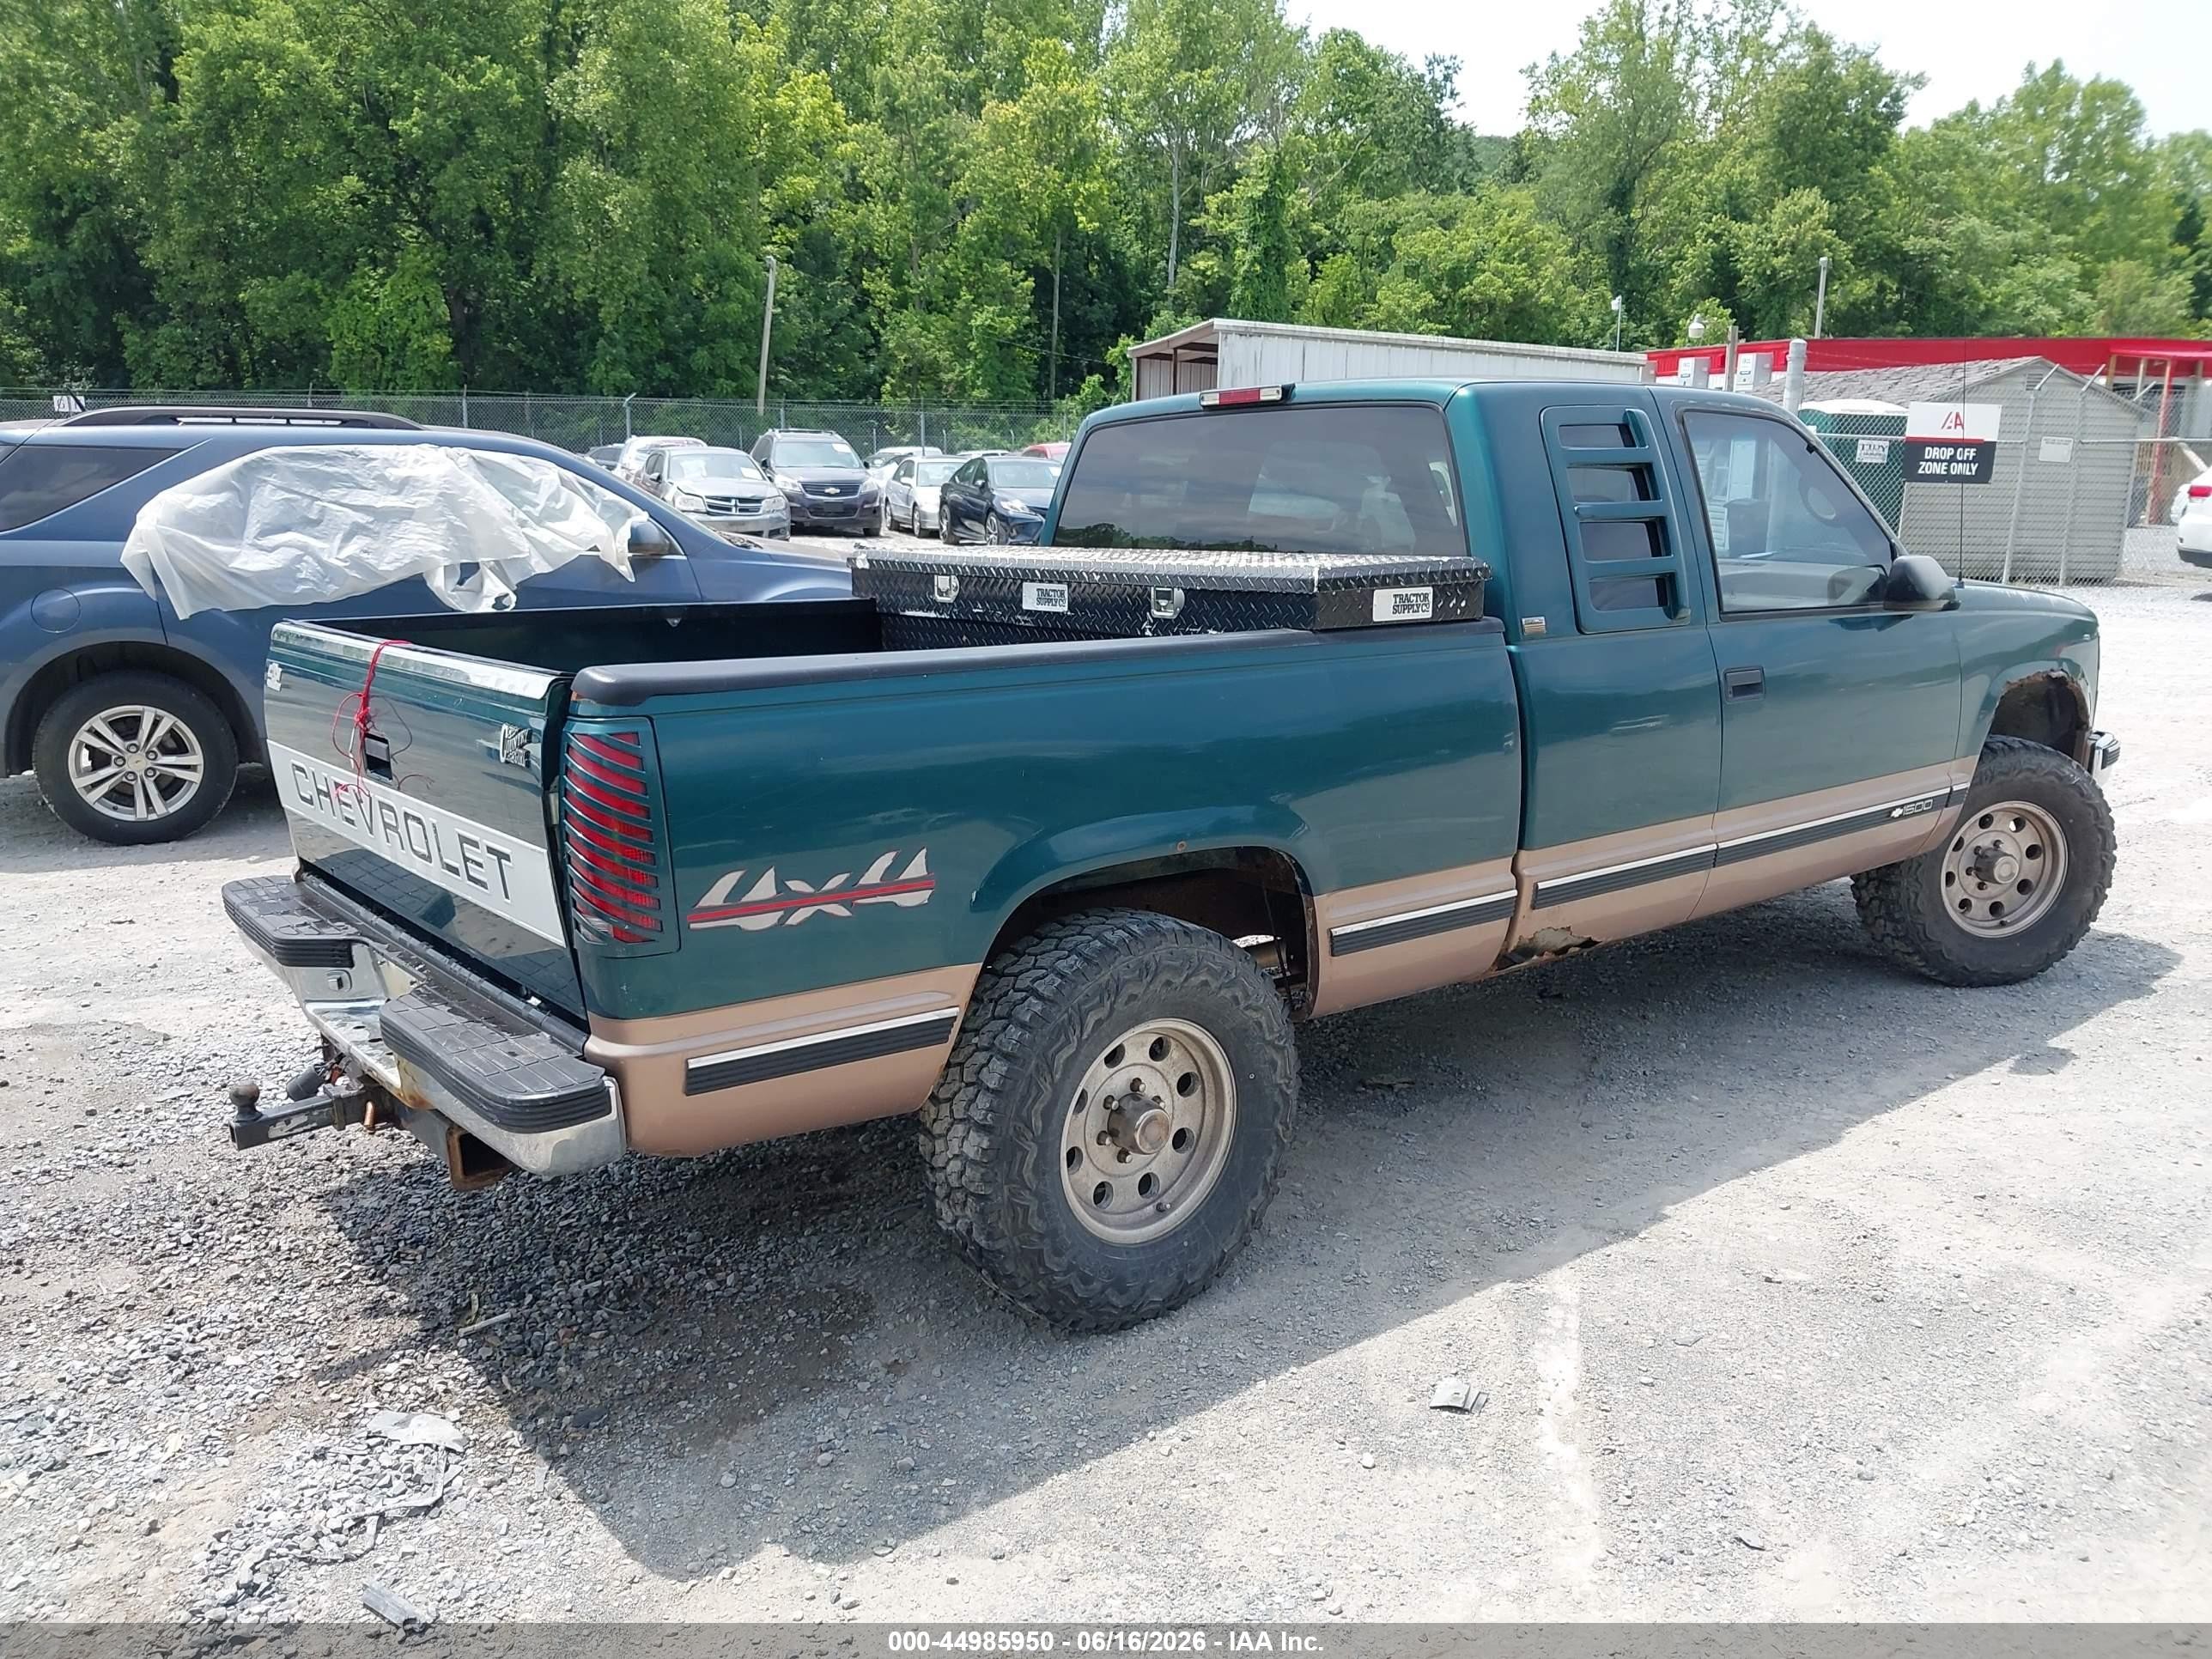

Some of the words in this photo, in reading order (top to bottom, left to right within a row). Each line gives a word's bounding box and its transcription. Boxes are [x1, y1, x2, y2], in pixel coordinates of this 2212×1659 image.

[1924, 447, 1954, 460] DROP
[1956, 447, 1977, 461] OFF
[1917, 461, 1948, 475] ZONE
[1950, 462, 1978, 476] ONLY
[1036, 588, 1066, 598] TRACTOR
[1393, 592, 1430, 604] TRACTOR
[1036, 598, 1058, 606] SUPPLY
[1392, 604, 1420, 614] SUPPLY
[1903, 799, 1933, 816] 1500
[290, 759, 513, 903] CHEVROLET
